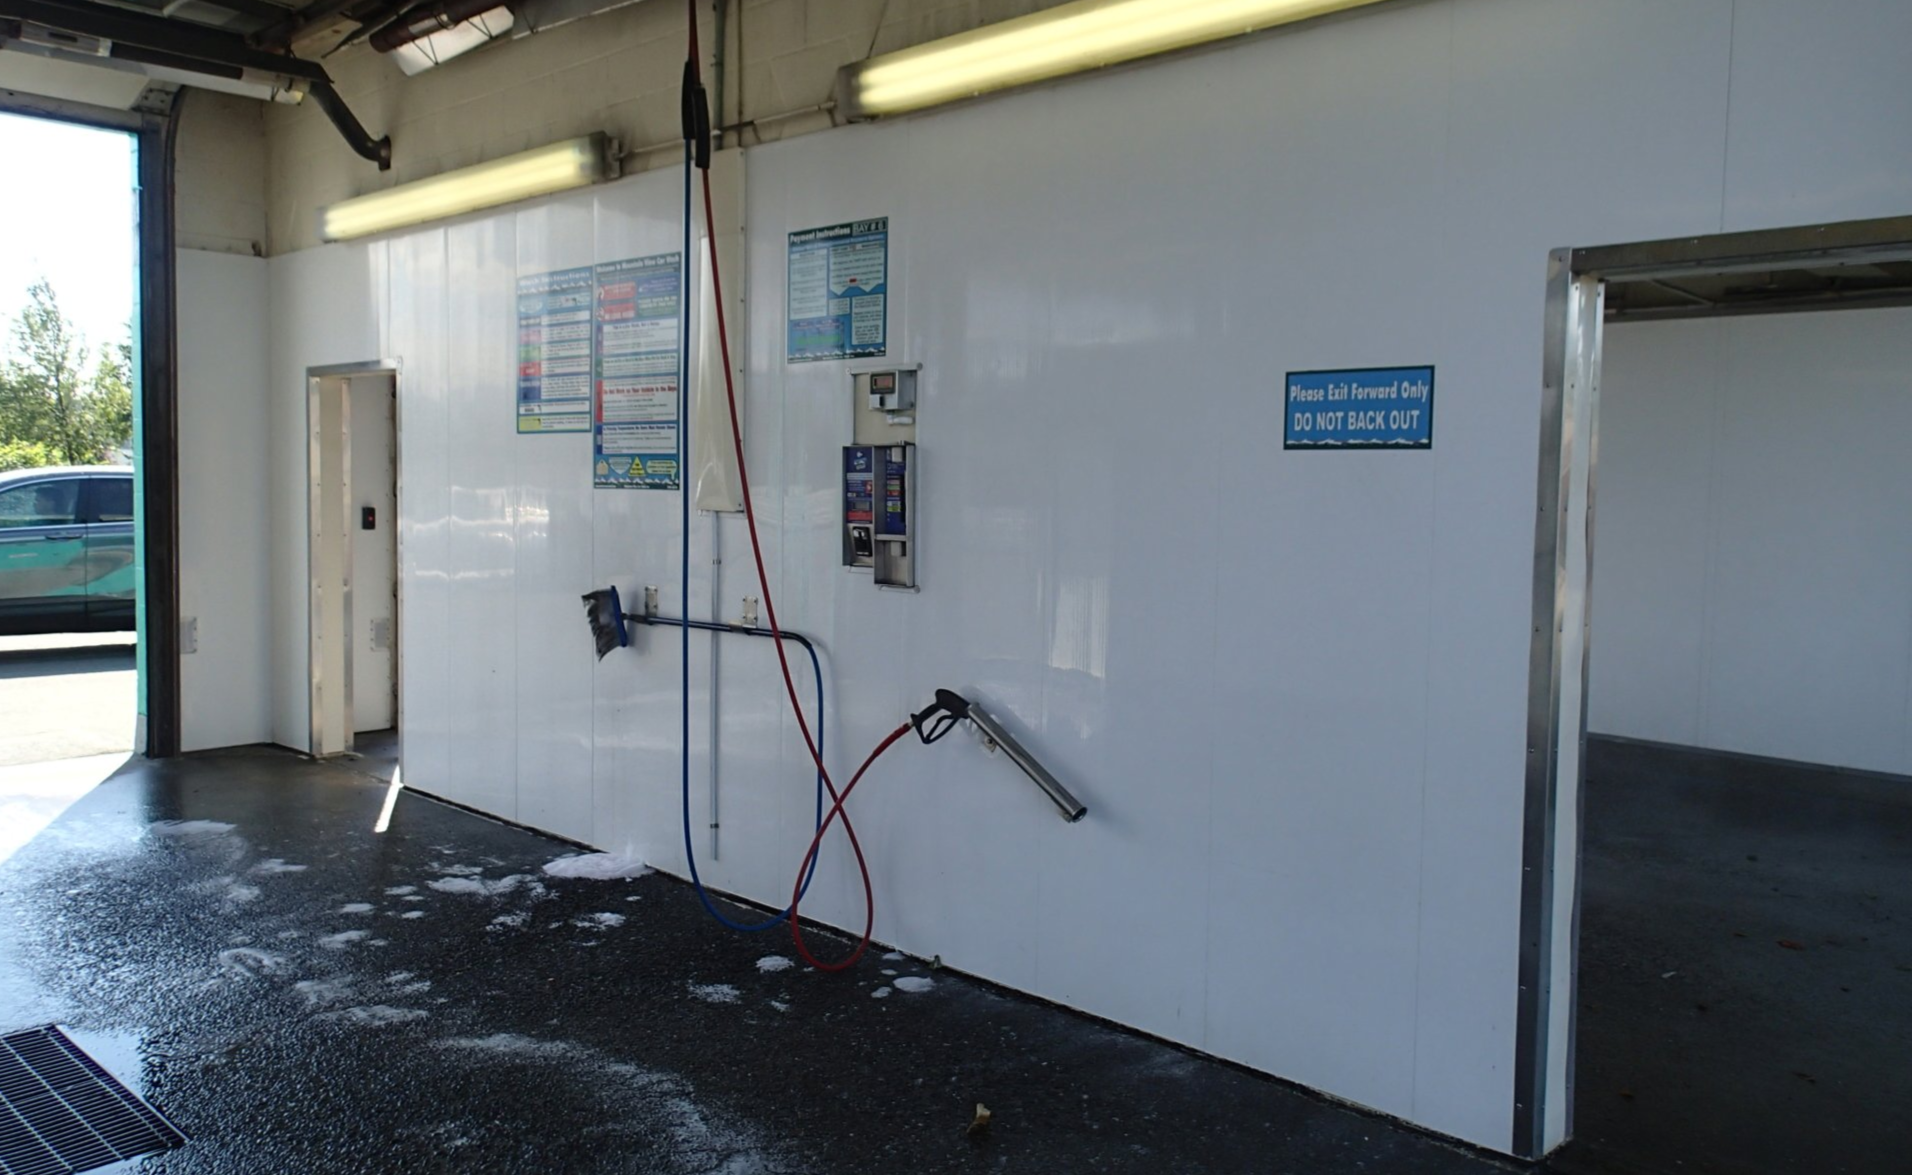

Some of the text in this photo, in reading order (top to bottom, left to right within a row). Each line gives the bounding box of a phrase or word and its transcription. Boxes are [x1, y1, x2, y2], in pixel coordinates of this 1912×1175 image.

[790, 232, 815, 244] Payment
[816, 226, 850, 239] Instructions
[853, 222, 869, 233] BAY
[1290, 380, 1429, 403] Please Exit Forward Only
[1294, 410, 1420, 431] DO NOT BACK OUT
